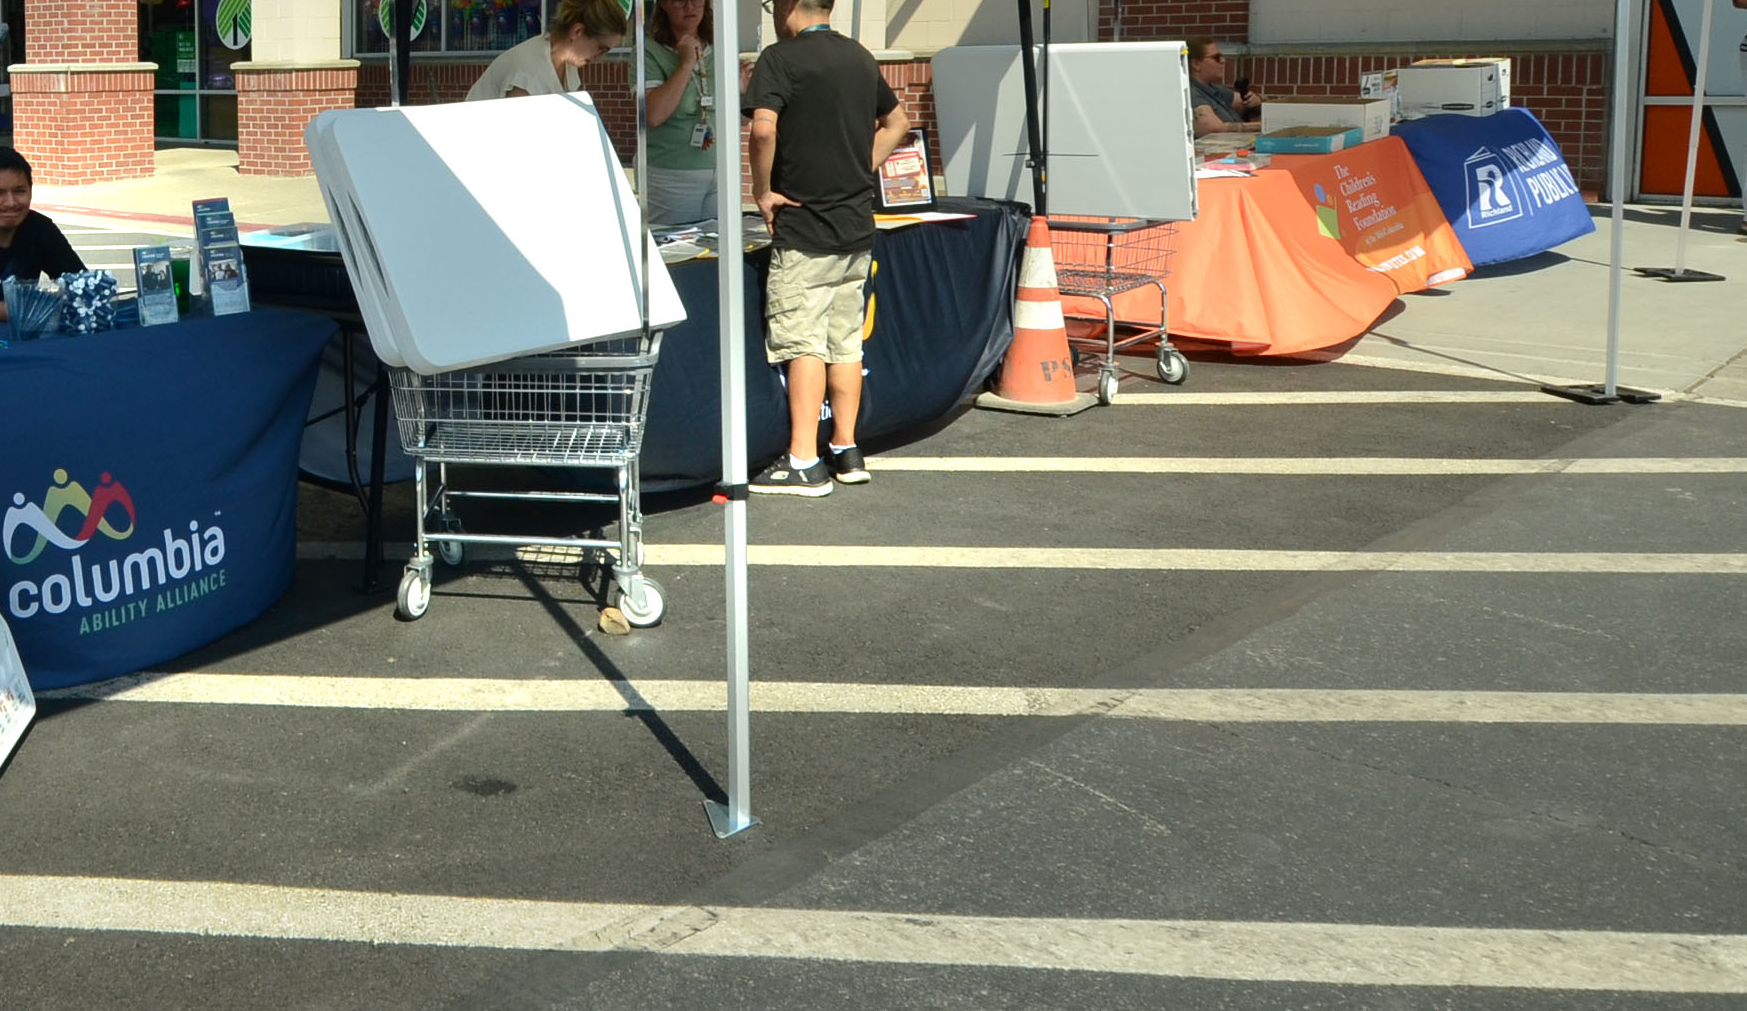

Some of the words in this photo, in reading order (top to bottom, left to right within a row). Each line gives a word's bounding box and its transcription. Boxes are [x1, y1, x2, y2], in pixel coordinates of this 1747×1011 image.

[1501, 138, 1557, 173] RICHLAND
[1333, 164, 1350, 180] The
[1340, 172, 1377, 196] Children's
[1346, 192, 1381, 213] Reading
[1480, 205, 1513, 219] Richland
[1353, 205, 1397, 231] Foundation
[9, 520, 226, 619] columbia
[79, 598, 148, 635] ABILITY
[156, 569, 227, 613] ALLIANCE
